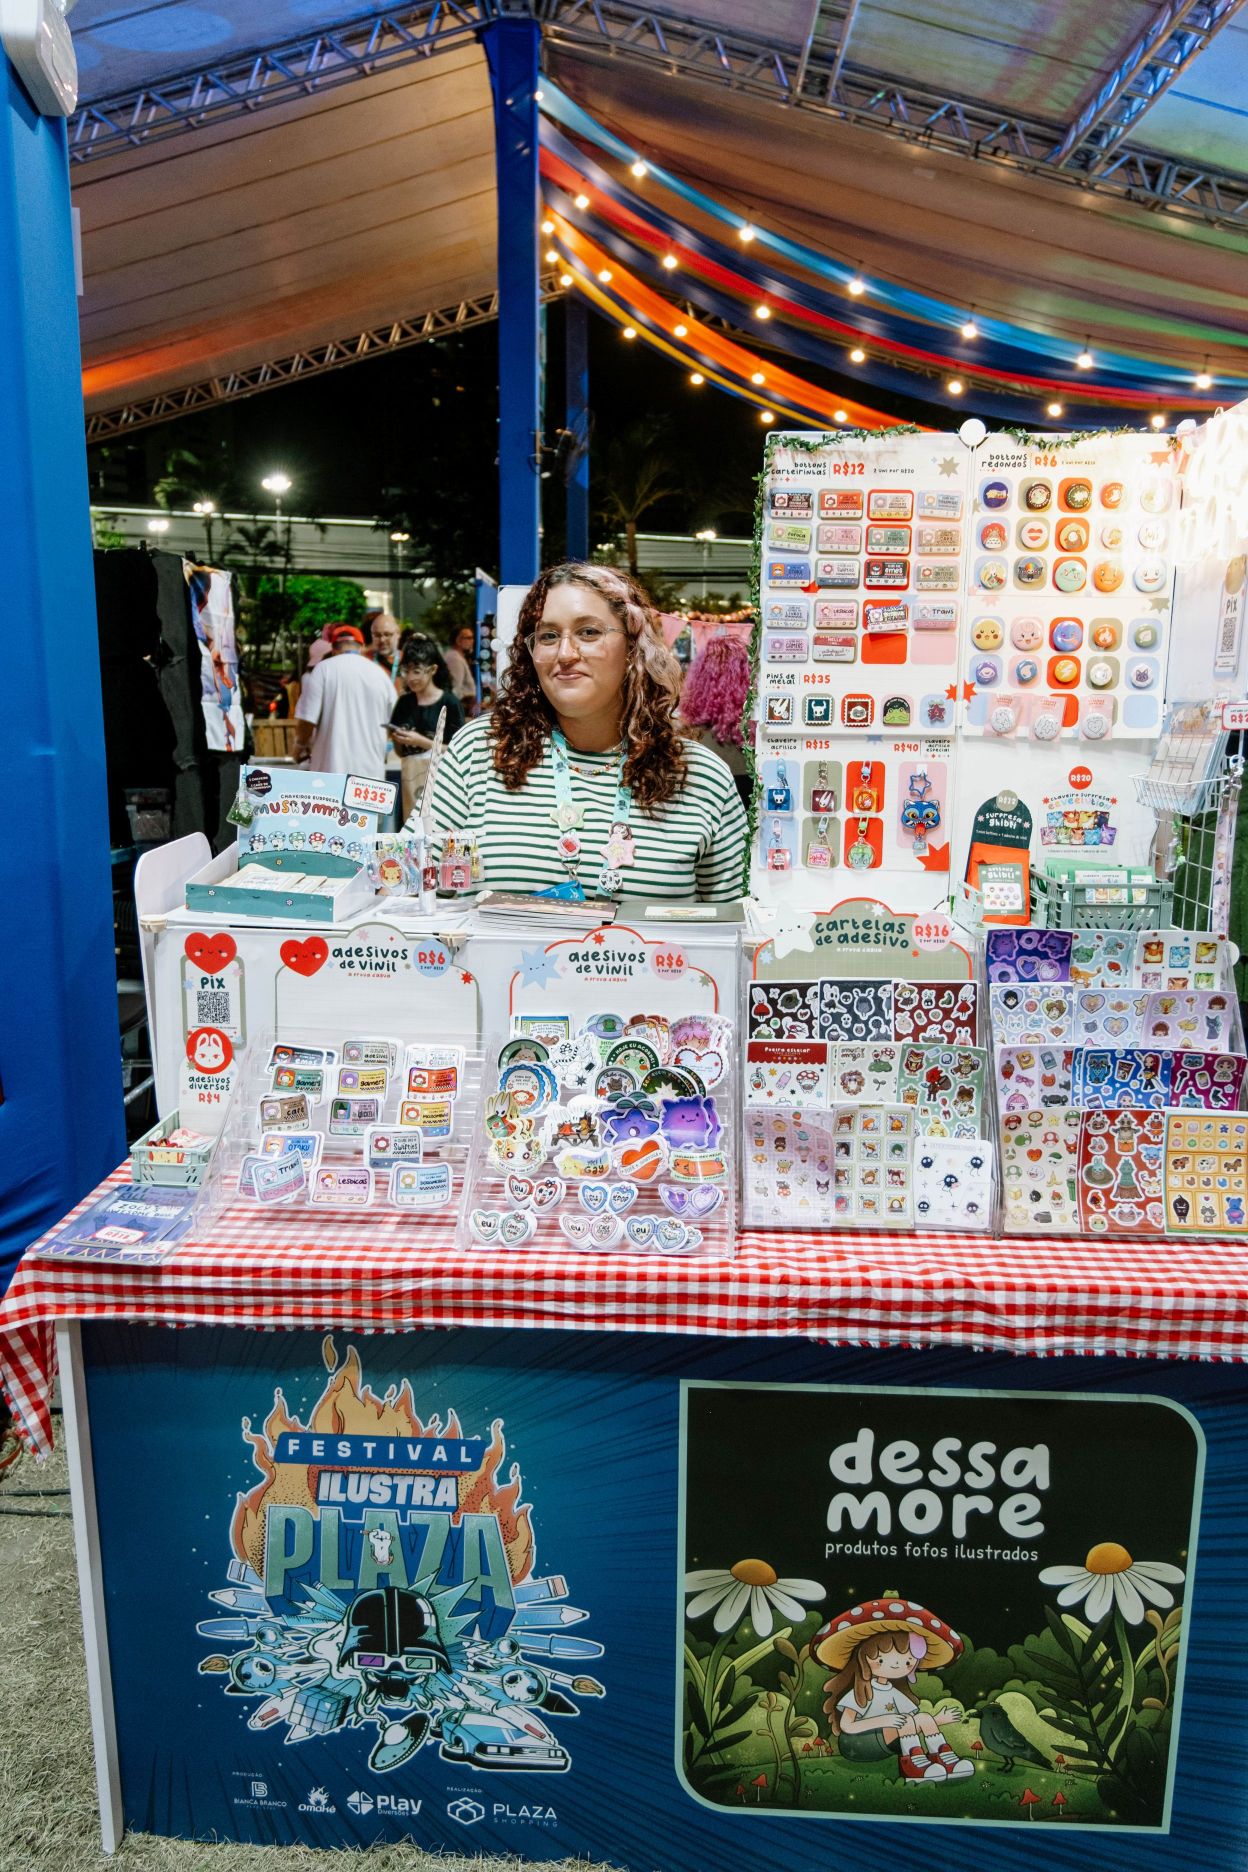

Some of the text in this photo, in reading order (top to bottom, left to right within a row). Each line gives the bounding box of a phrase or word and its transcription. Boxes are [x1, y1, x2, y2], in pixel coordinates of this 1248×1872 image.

[981, 460, 1028, 468] redondos
[989, 453, 1028, 461] bottons
[1034, 454, 1057, 468] R$6
[770, 467, 827, 476] carteirinhas
[832, 461, 865, 476] R$12
[766, 672, 783, 680] pins
[803, 672, 831, 685] R$35
[805, 740, 830, 750] R$15
[893, 742, 919, 752] R$40
[353, 787, 386, 804] R$35
[815, 919, 907, 934] cartelas
[915, 923, 949, 938] R$16
[815, 932, 909, 949] de adesivo
[332, 946, 408, 960] adesivos
[418, 949, 446, 965] R$6
[568, 950, 646, 963] adesivos
[339, 959, 397, 972] de vinil
[655, 953, 684, 968] R$6
[575, 963, 634, 976] de vinil
[188, 1076, 231, 1084] adesivos
[188, 1083, 230, 1091] diversos
[360, 1079, 385, 1087] gamers
[198, 1091, 220, 1104] R$4
[288, 1439, 472, 1462] FESTIVAL
[828, 1427, 1050, 1491] dessa
[318, 1471, 458, 1507] ILUSTRA
[826, 1488, 1045, 1539] more
[825, 1540, 1039, 1562] produtos fofos ilustrados
[264, 1505, 514, 1612] PLAZA
[234, 1798, 258, 1806] BIANCA
[259, 1800, 288, 1808] BRANCO
[377, 1795, 422, 1815] Play
[493, 1803, 558, 1820] PLAZA
[493, 1817, 559, 1828] SHOPPING
